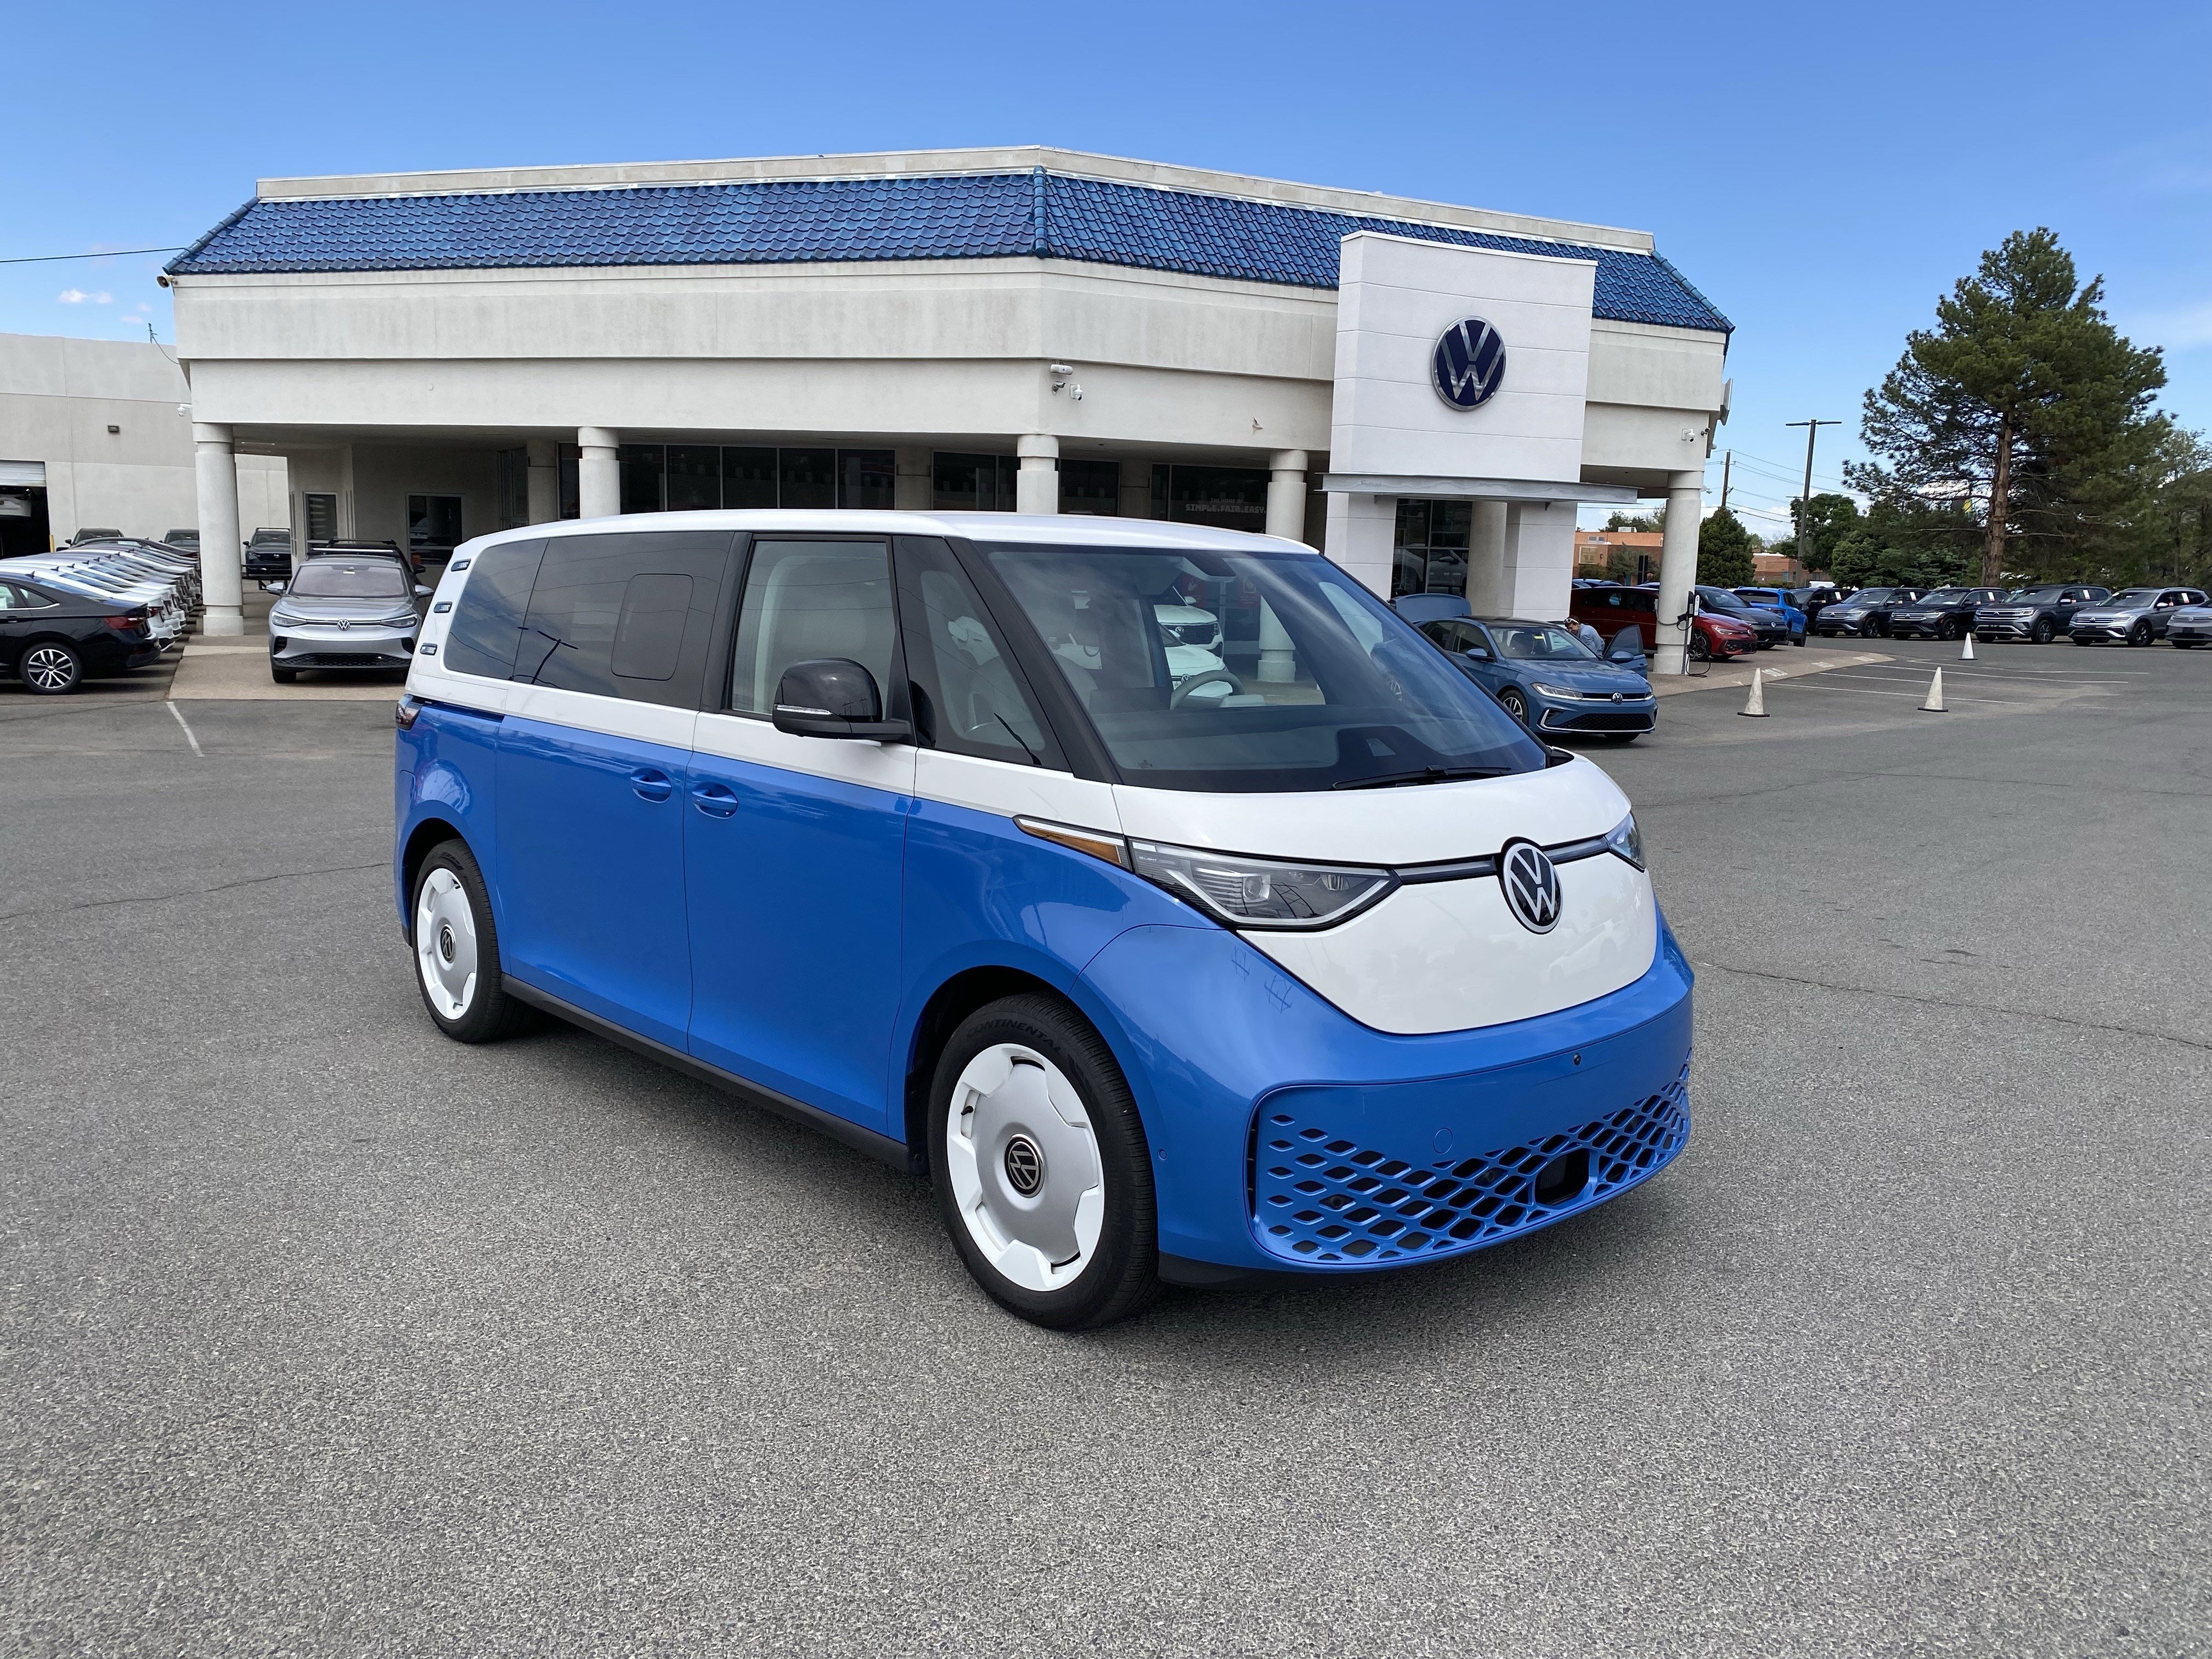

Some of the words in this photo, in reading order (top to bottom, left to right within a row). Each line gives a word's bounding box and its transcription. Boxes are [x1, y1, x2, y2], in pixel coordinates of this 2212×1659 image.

[1434, 316, 1506, 410] VW
[337, 619, 350, 631] VW
[1504, 843, 1564, 933] VW
[1007, 1138, 1041, 1193] VW
